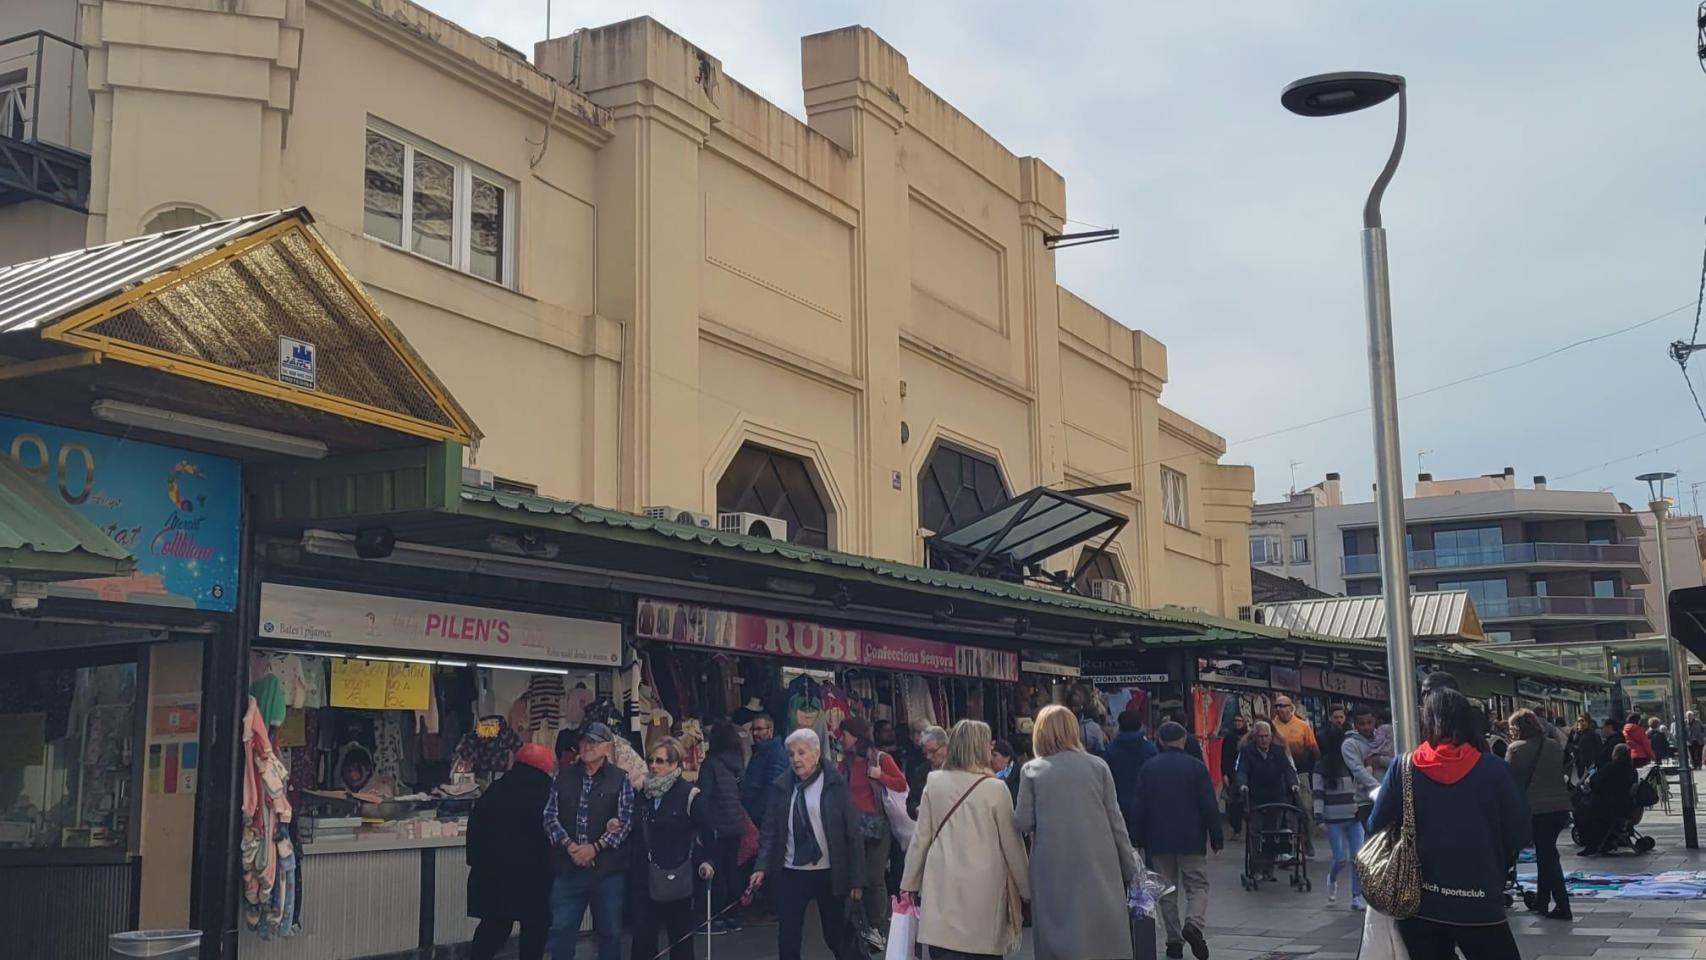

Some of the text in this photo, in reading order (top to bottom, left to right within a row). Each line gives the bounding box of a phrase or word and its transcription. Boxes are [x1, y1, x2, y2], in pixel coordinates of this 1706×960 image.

[425, 613, 511, 644] PILEN'S
[764, 618, 859, 662] RUBI
[865, 643, 954, 669] Confeccions Senyora
[1119, 675, 1152, 683] SENYORA
[1441, 888, 1485, 898] sportsclub
